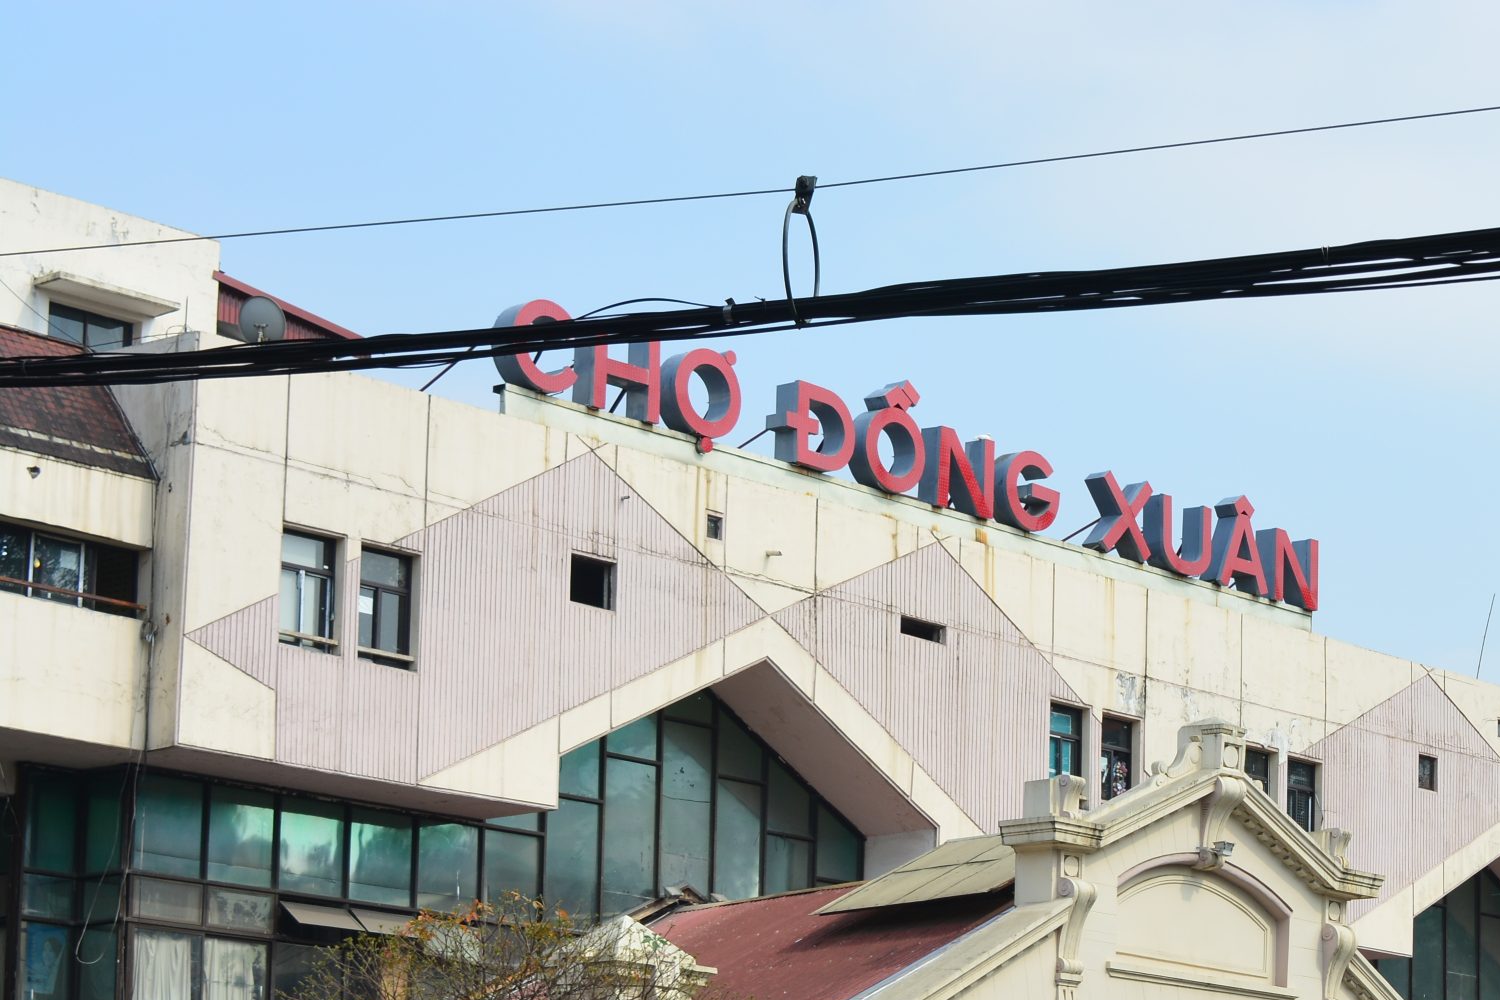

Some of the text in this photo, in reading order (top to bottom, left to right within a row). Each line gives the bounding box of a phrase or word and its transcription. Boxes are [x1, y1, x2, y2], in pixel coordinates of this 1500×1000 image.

[494, 298, 1320, 612] CHỢ ĐỒNG XUÂN
